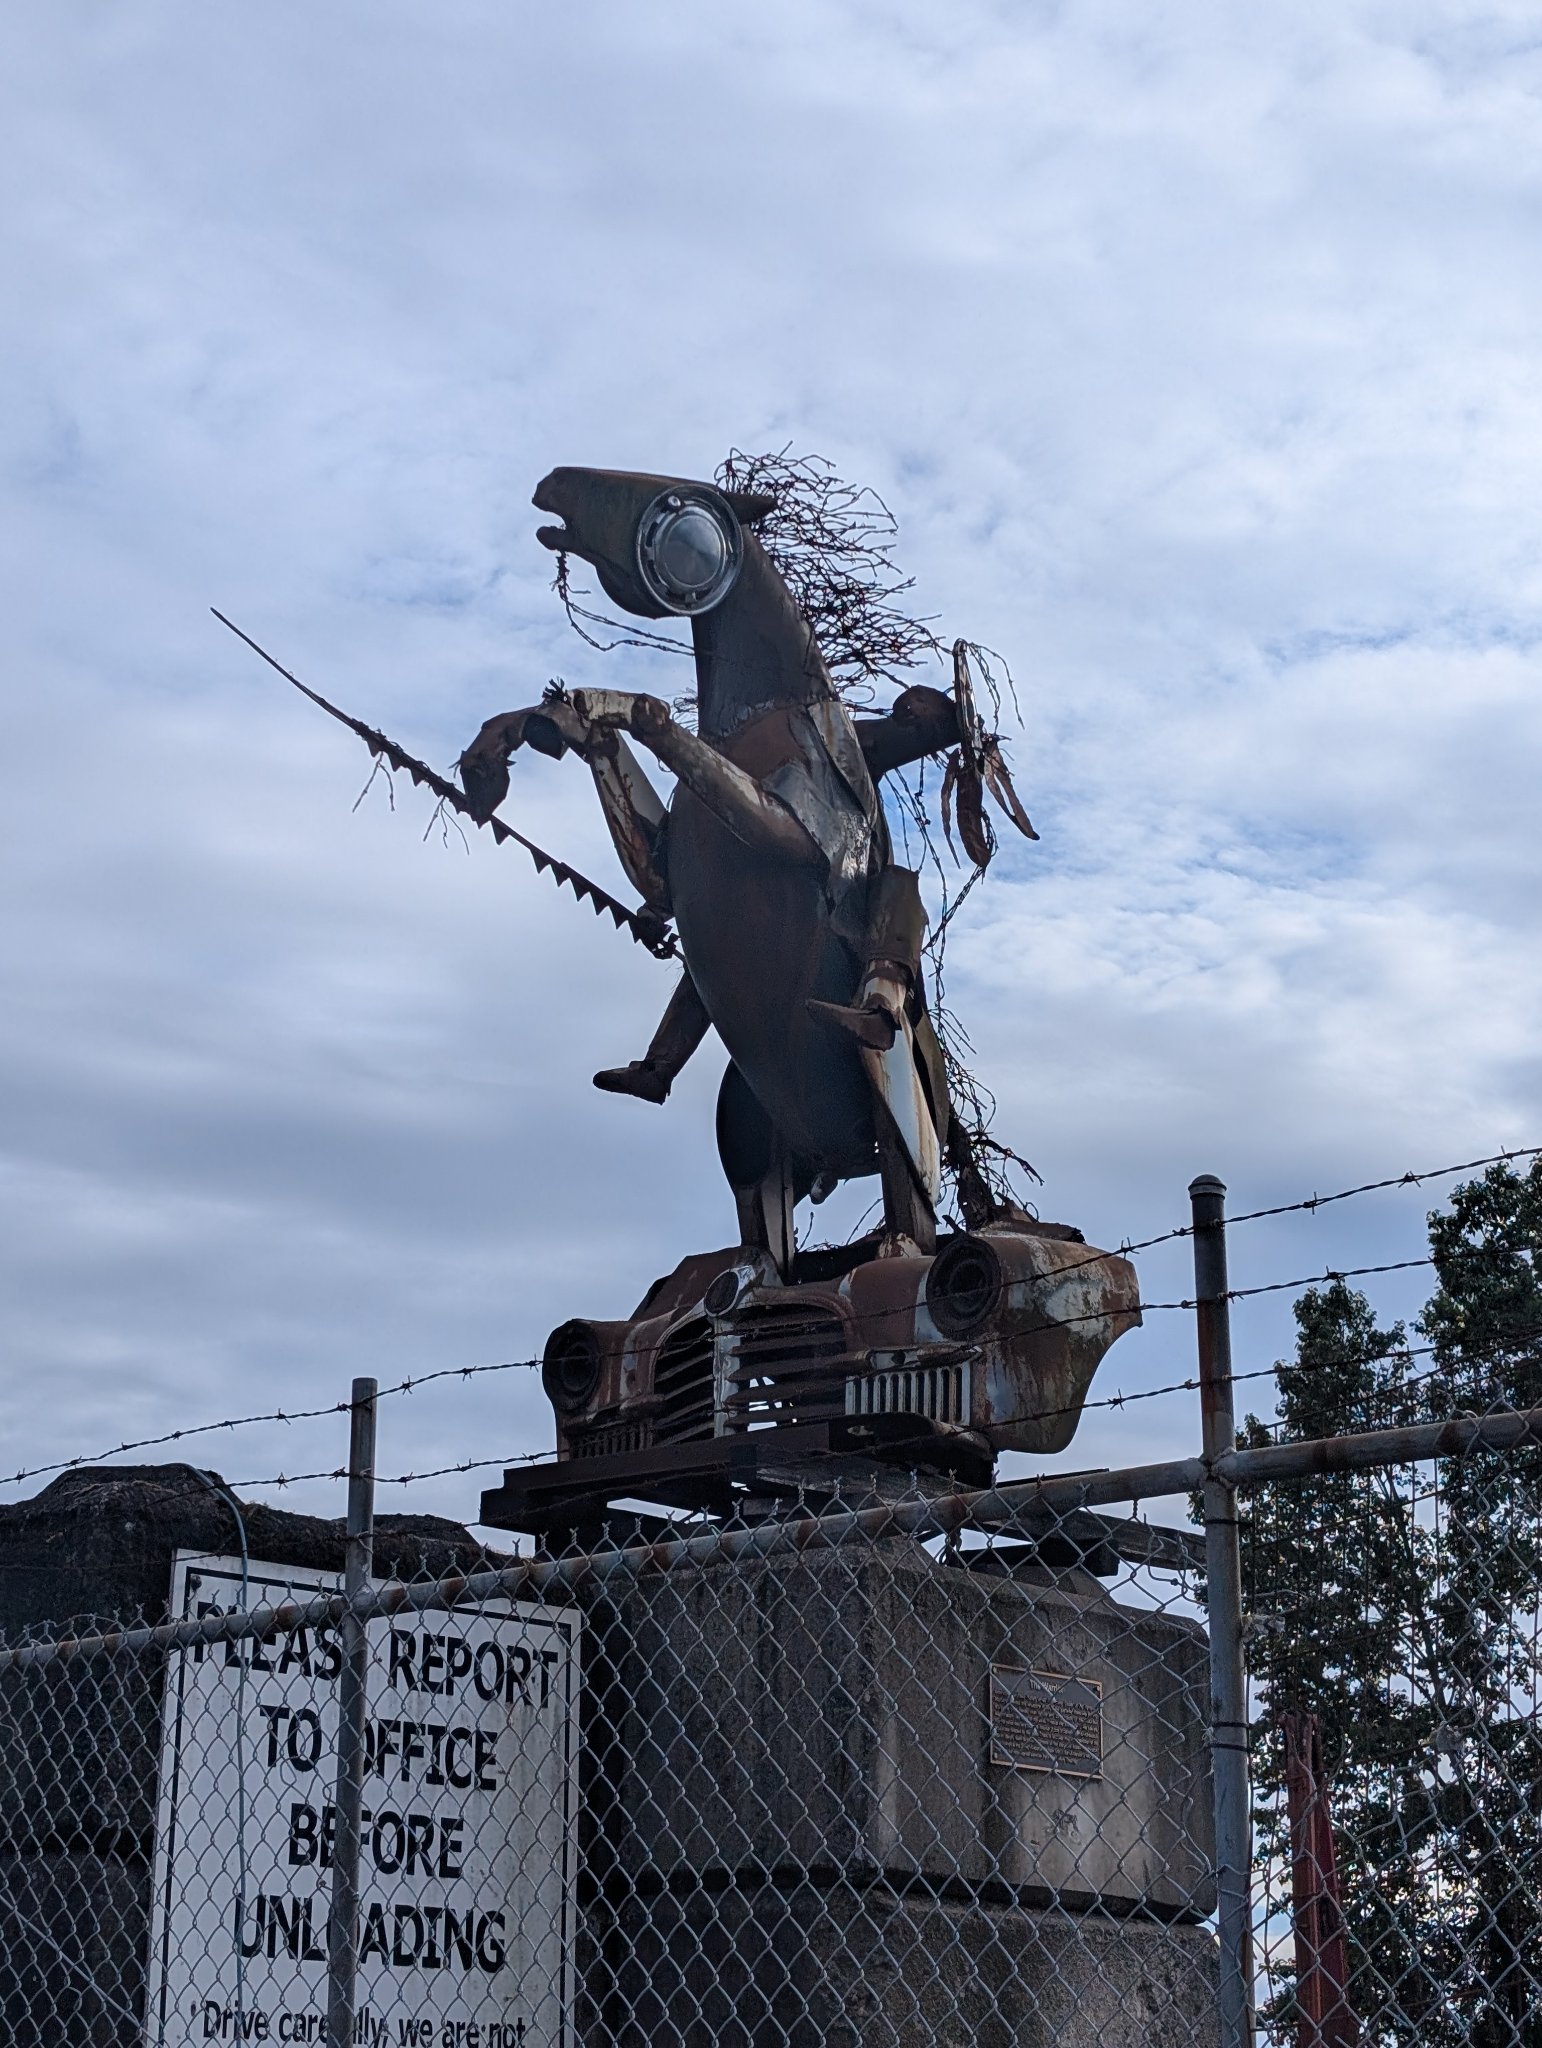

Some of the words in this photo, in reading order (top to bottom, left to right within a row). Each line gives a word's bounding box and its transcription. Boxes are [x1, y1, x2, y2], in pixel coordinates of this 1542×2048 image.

[194, 1602, 342, 1680] PLEAS
[389, 1629, 558, 1708] REPORT
[260, 1705, 322, 1772] TO
[235, 1893, 506, 1974] UNLADING
[203, 2000, 269, 2042] Drive
[278, 2006, 388, 2048] carelly,
[399, 2018, 434, 2048] we
[442, 2020, 480, 2048] are
[488, 2017, 526, 2048] not
